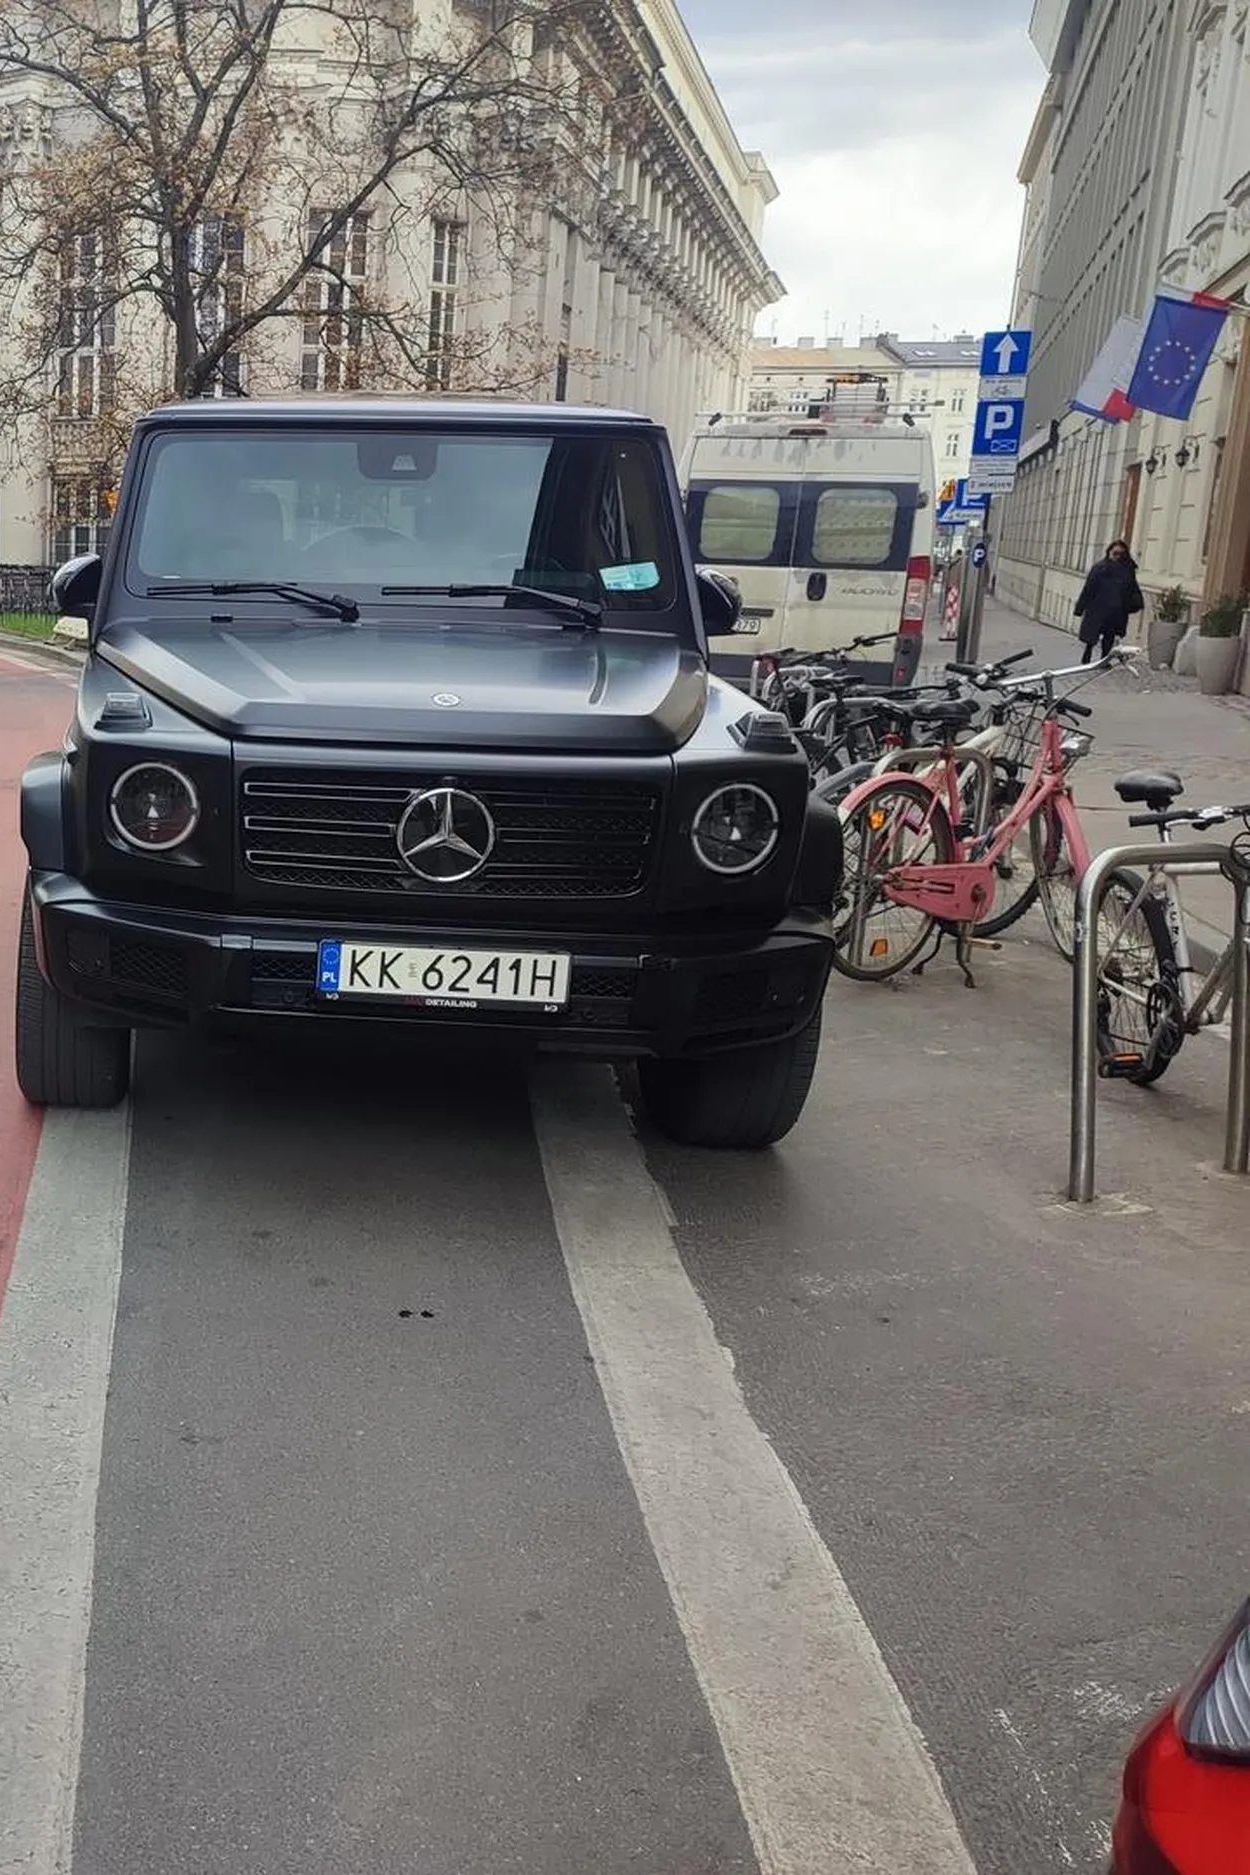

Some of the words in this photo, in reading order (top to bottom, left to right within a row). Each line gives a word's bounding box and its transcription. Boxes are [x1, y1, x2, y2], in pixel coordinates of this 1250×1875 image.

[984, 404, 1015, 440] P
[972, 548, 986, 563] P
[322, 971, 338, 983] PL
[349, 950, 404, 990] KK
[421, 954, 557, 998] 6241H
[425, 998, 478, 1009] DETAILING
